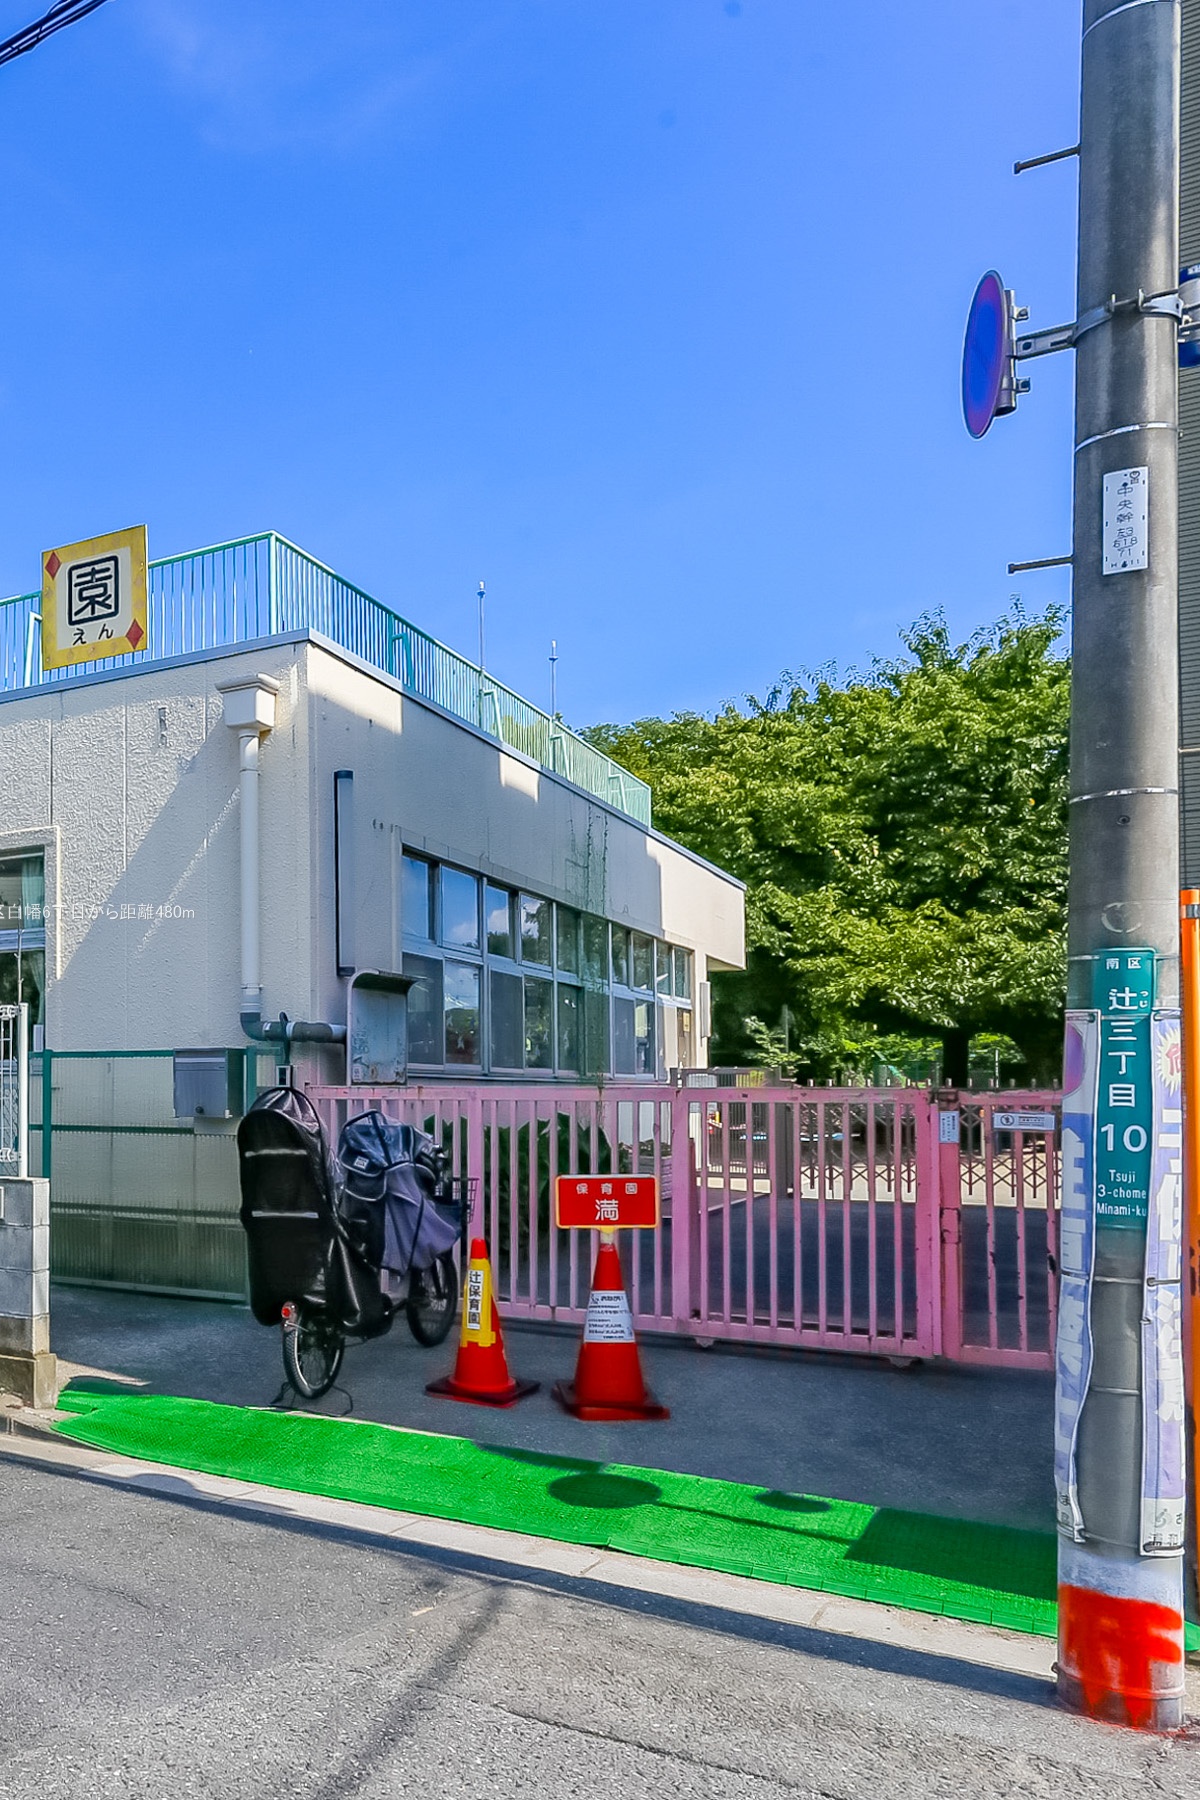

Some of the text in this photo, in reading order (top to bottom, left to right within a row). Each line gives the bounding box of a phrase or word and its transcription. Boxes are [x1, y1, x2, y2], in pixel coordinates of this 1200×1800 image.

[67, 553, 120, 627] 園
[72, 625, 113, 647] えん
[1106, 957, 1141, 970] 南区
[1139, 990, 1149, 1008] つじ
[1108, 986, 1138, 1108] 辻三丁目
[1101, 1123, 1147, 1152] 10
[1109, 1169, 1136, 1184] Tsuji
[576, 1182, 638, 1195] 保育園
[1097, 1184, 1147, 1199] 3-chome
[595, 1199, 619, 1221] 満
[1096, 1202, 1147, 1217] Minami-ku
[468, 1270, 482, 1324] 辻保育園
